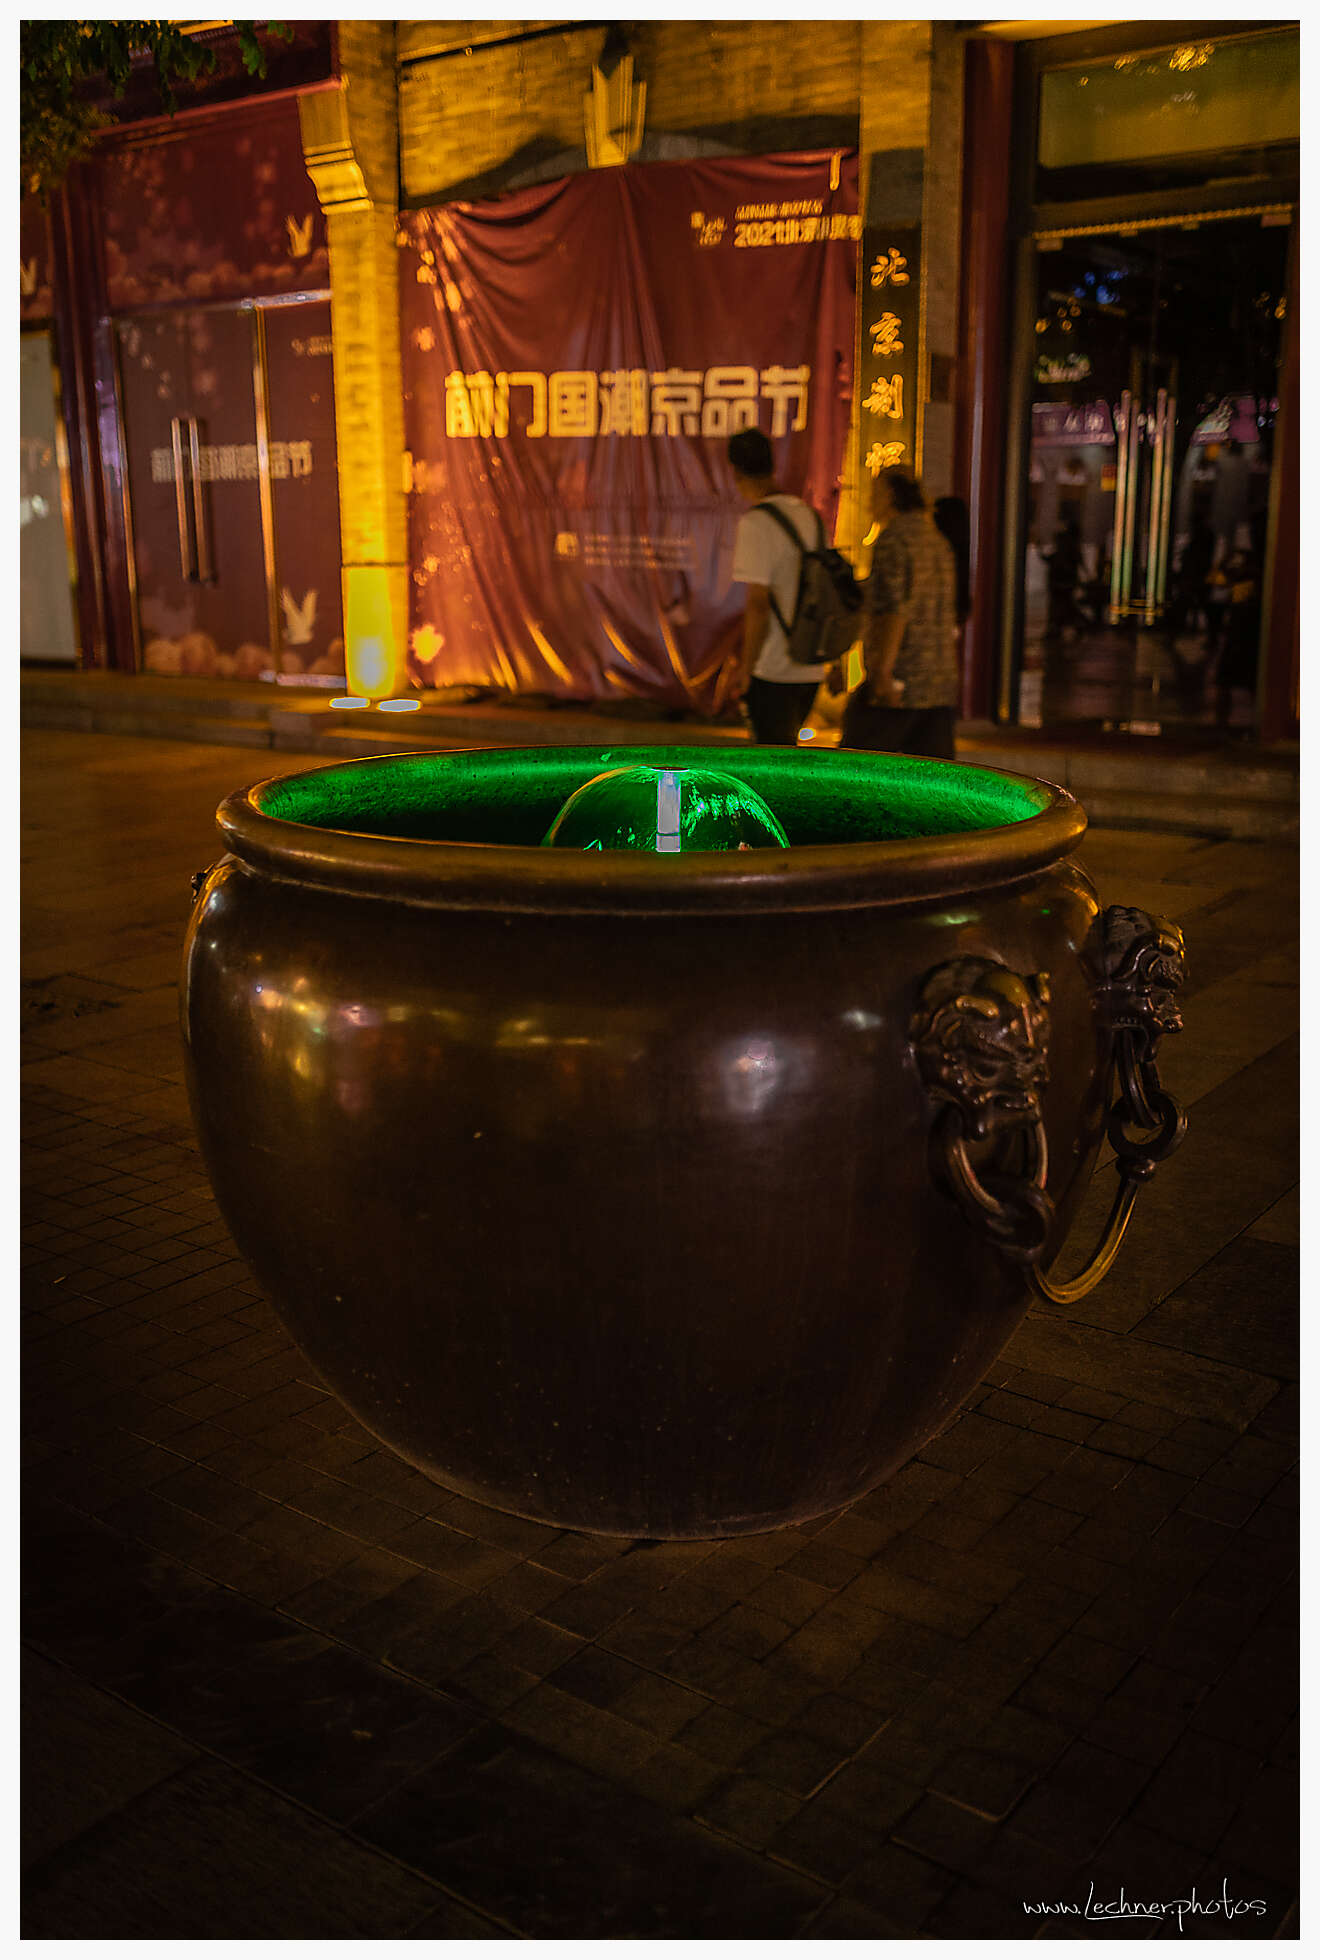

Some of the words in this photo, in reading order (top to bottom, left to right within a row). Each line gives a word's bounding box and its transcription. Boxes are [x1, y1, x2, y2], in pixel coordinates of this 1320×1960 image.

[444, 364, 811, 439] 前门国潮京品节
[862, 247, 910, 546] 北京制帽
